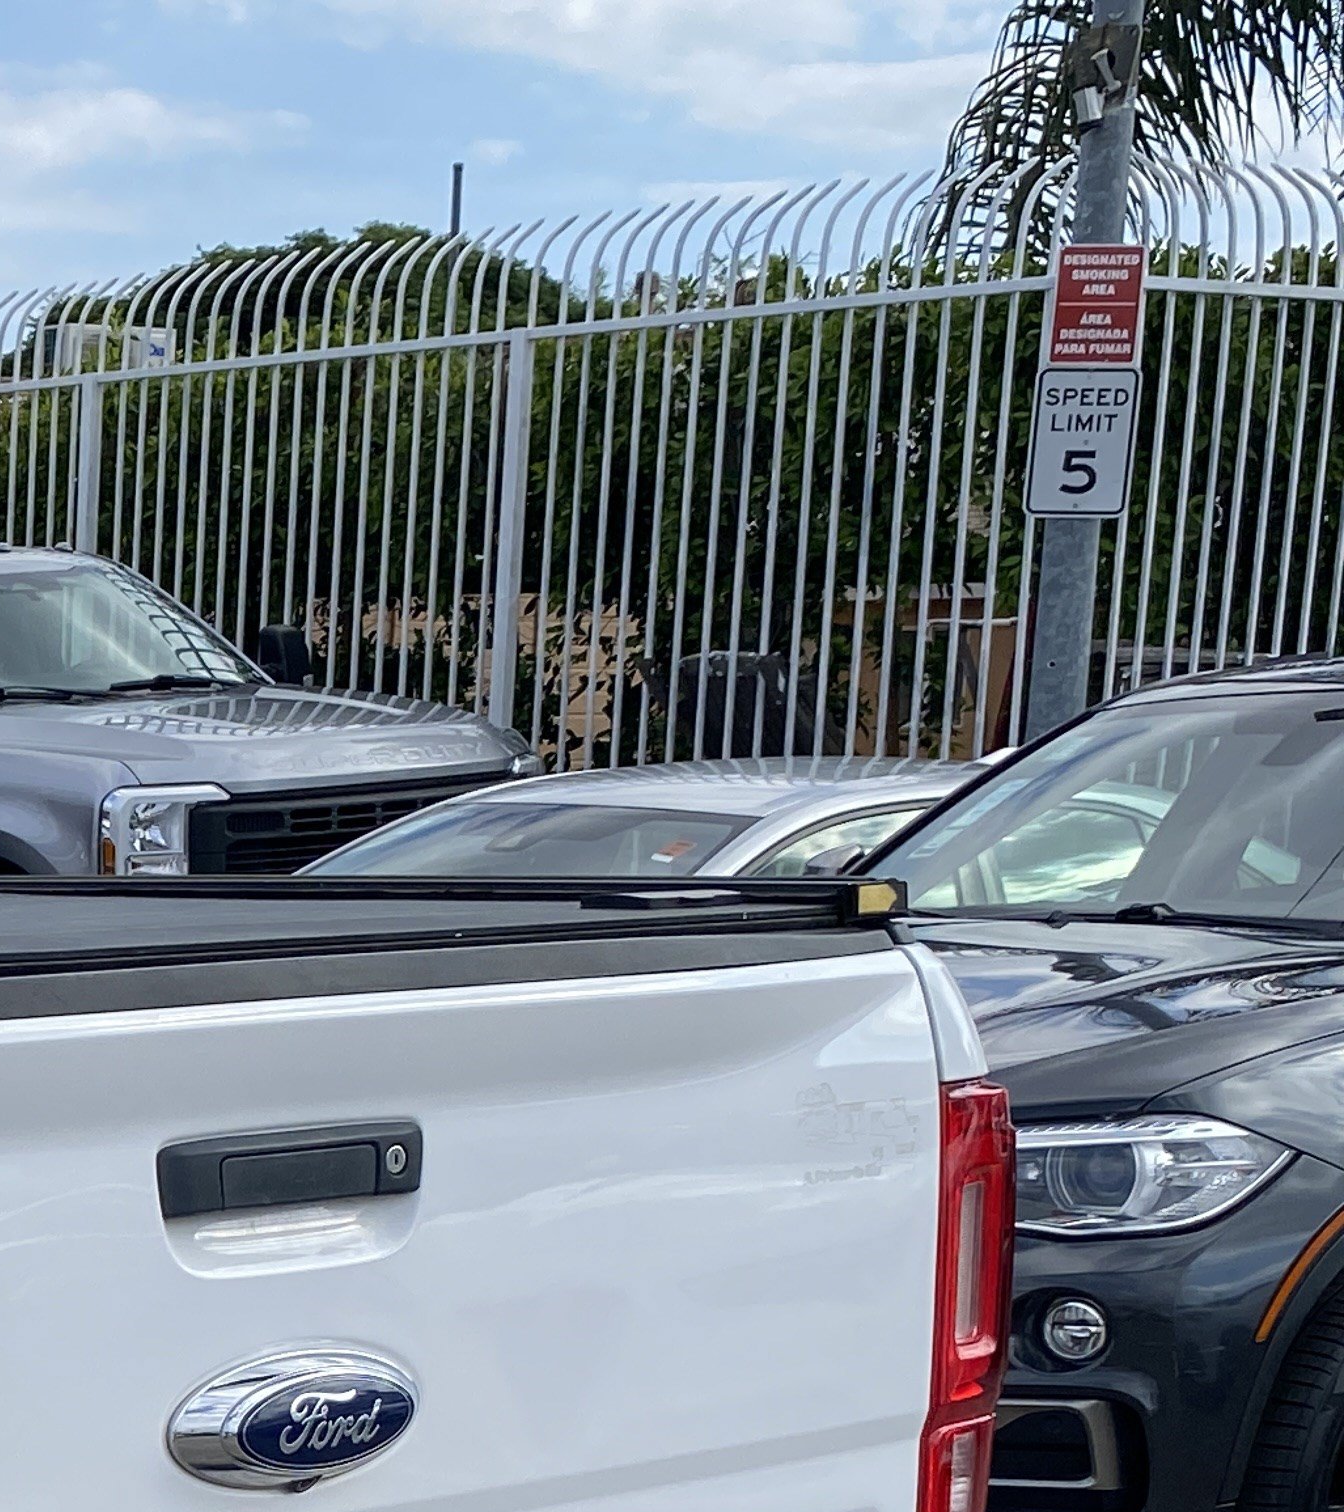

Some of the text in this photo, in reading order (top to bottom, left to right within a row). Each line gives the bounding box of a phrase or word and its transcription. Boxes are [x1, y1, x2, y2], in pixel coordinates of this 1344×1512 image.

[1064, 254, 1140, 266] DESIGNATED
[1072, 269, 1129, 280] SMOKING
[1082, 284, 1115, 296] AREA
[1059, 328, 1129, 340] DESIGNADA
[1054, 343, 1132, 355] PARA FUMAR
[1045, 388, 1129, 407] SPEED
[1051, 414, 1118, 433] LIMIT
[1059, 450, 1097, 494] 5
[279, 1388, 382, 1455] Ford
